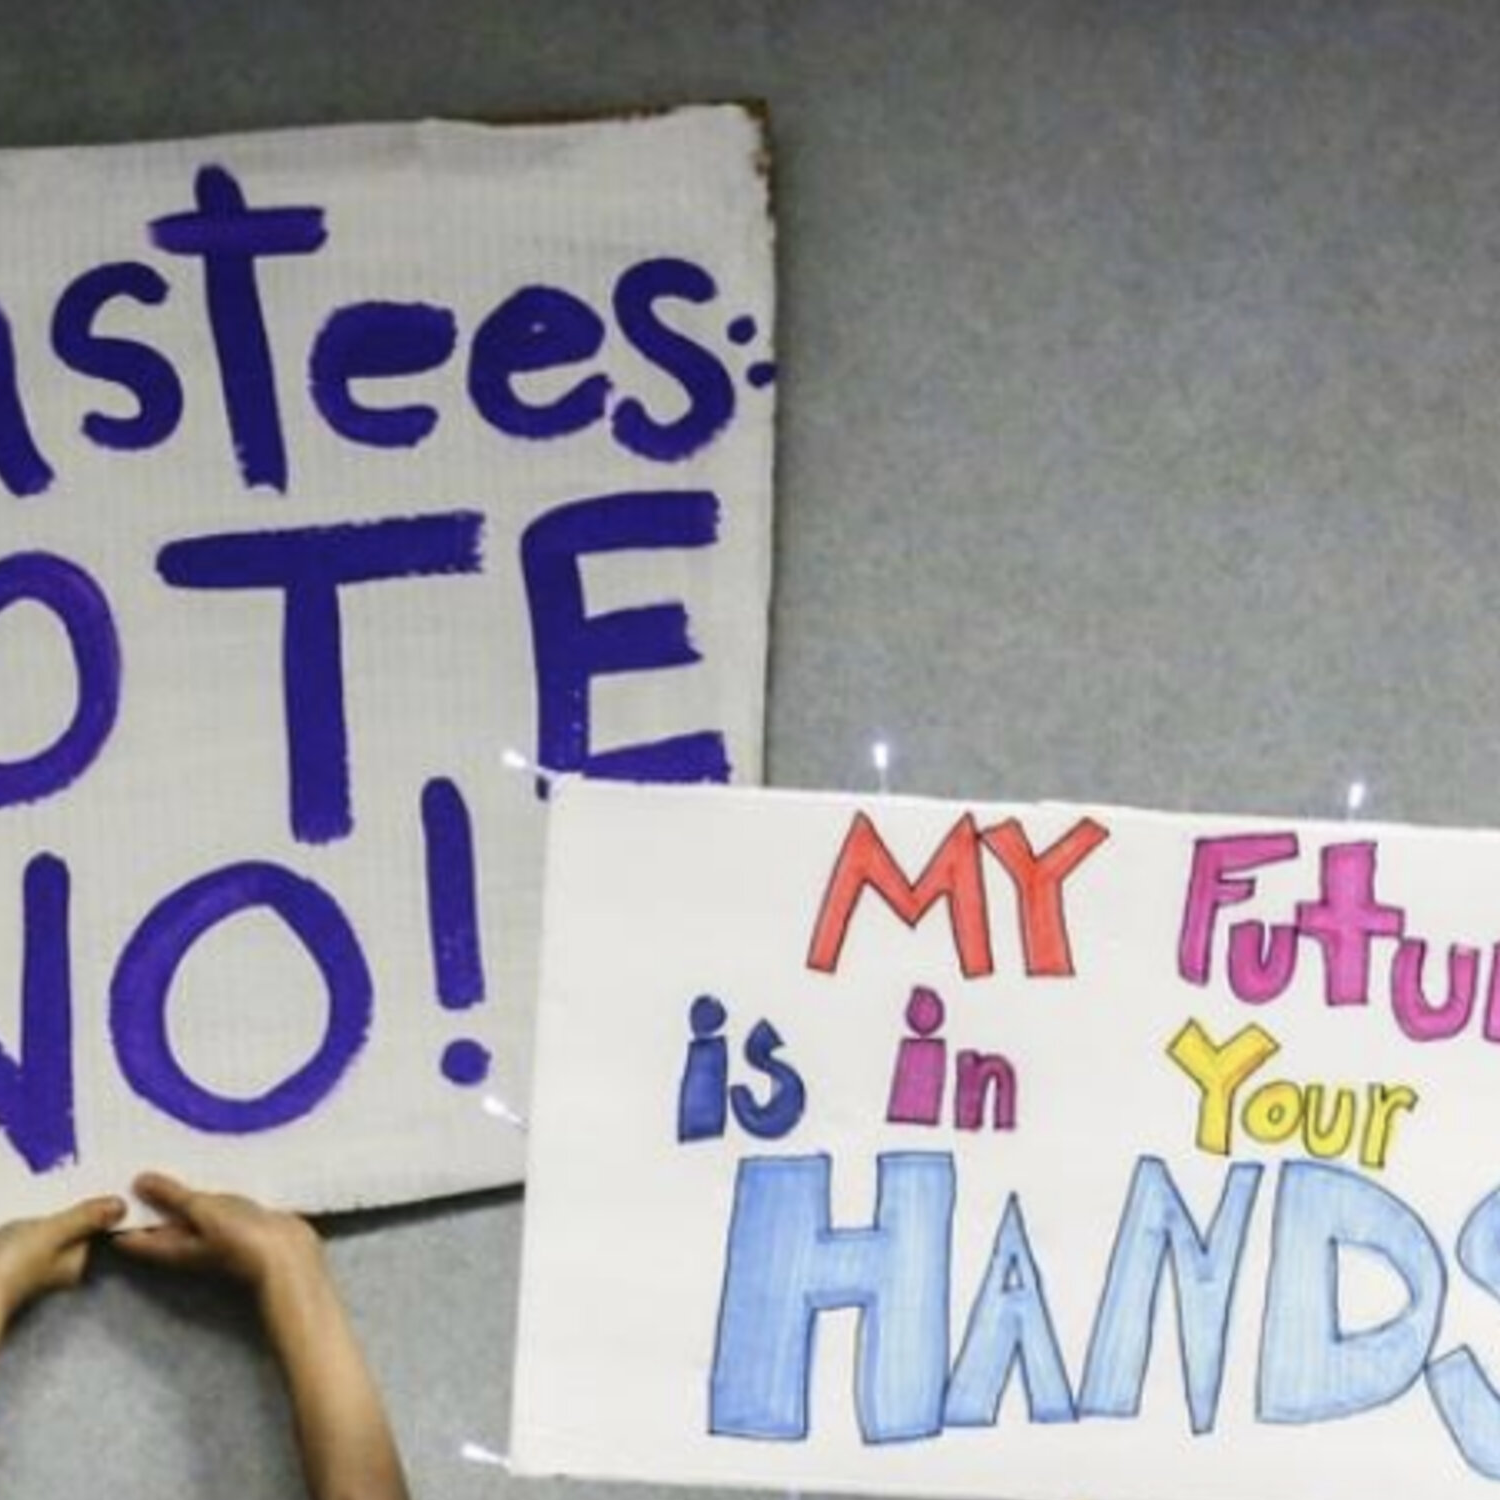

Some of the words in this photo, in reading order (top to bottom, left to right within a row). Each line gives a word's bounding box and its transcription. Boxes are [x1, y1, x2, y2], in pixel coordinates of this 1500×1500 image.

[806, 809, 1110, 979] MY
[1177, 831, 1500, 1042] Futu
[677, 994, 806, 1143] is
[886, 985, 1017, 1131] in
[1165, 1017, 1419, 1169] Your
